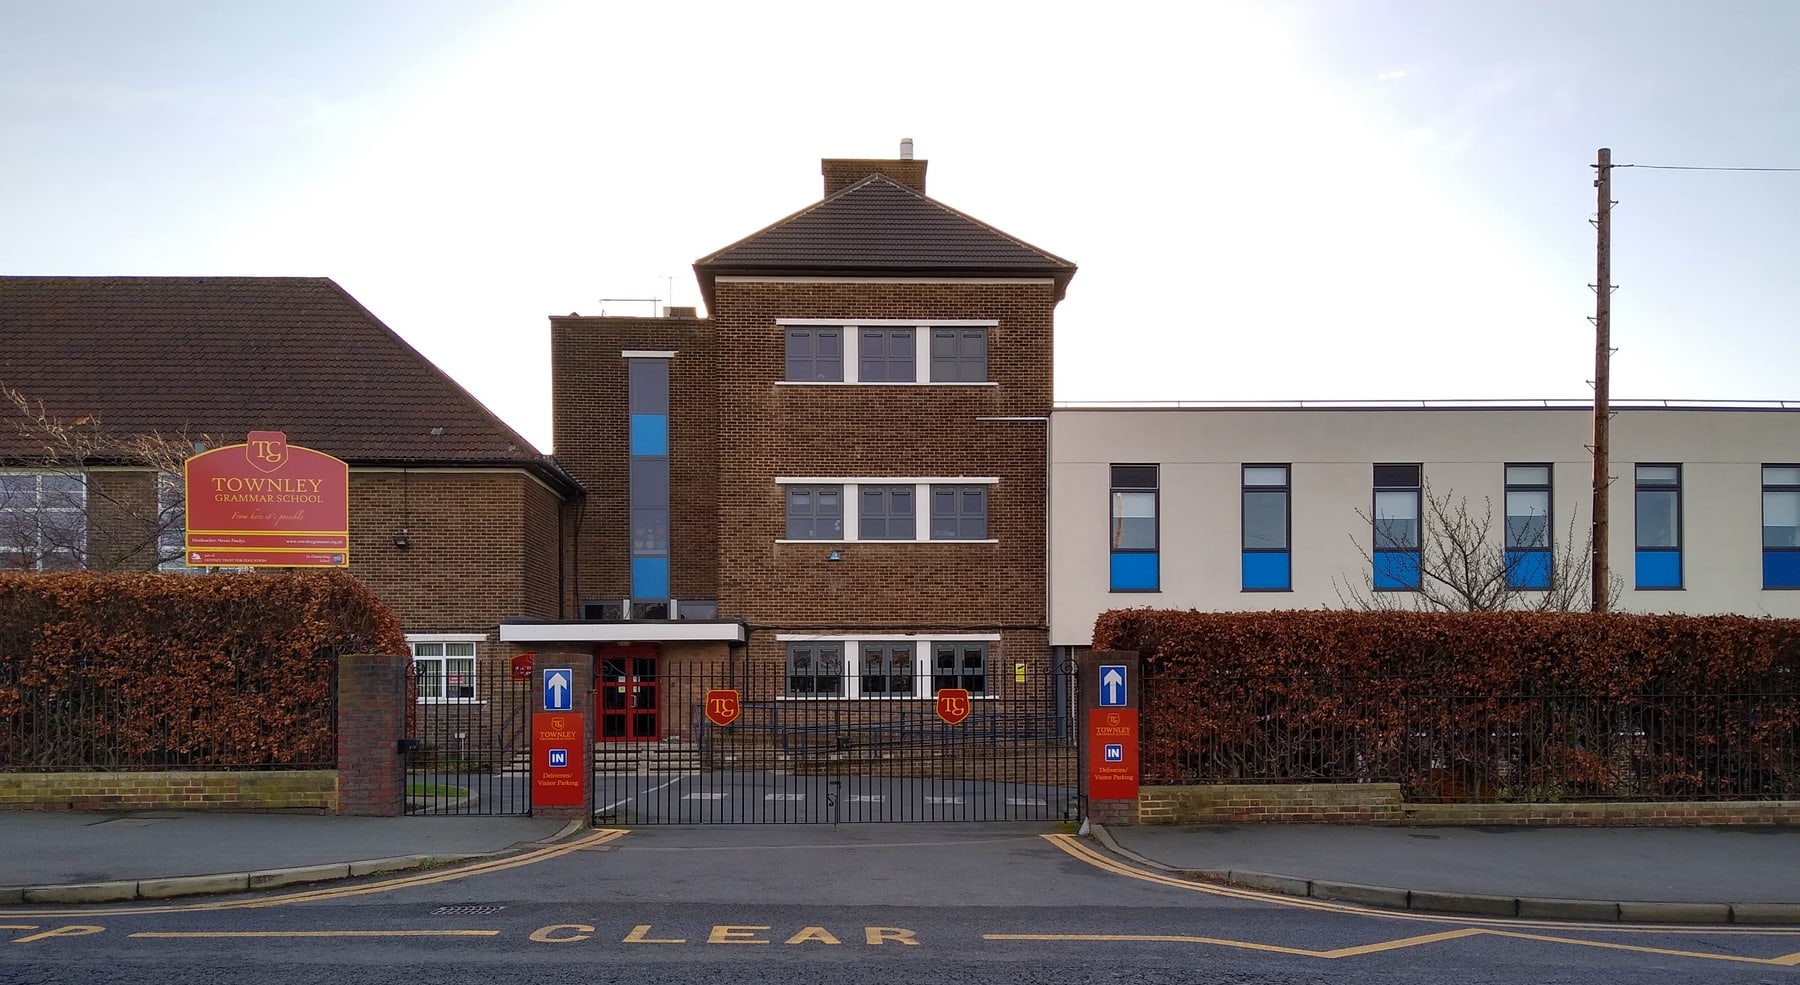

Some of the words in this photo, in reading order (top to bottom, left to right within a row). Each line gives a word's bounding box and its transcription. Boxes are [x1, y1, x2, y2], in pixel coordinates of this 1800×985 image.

[252, 440, 281, 462] TG
[212, 478, 322, 493] TOWNLEY
[214, 494, 274, 503] GRAMMAR
[276, 494, 324, 503] SCHOOL
[232, 511, 247, 520] From
[273, 510, 304, 527] possible
[711, 698, 734, 717] TG
[941, 697, 964, 716] TG
[552, 753, 564, 763] IN
[1108, 748, 1120, 758] IN
[529, 924, 920, 945] CLEAR
